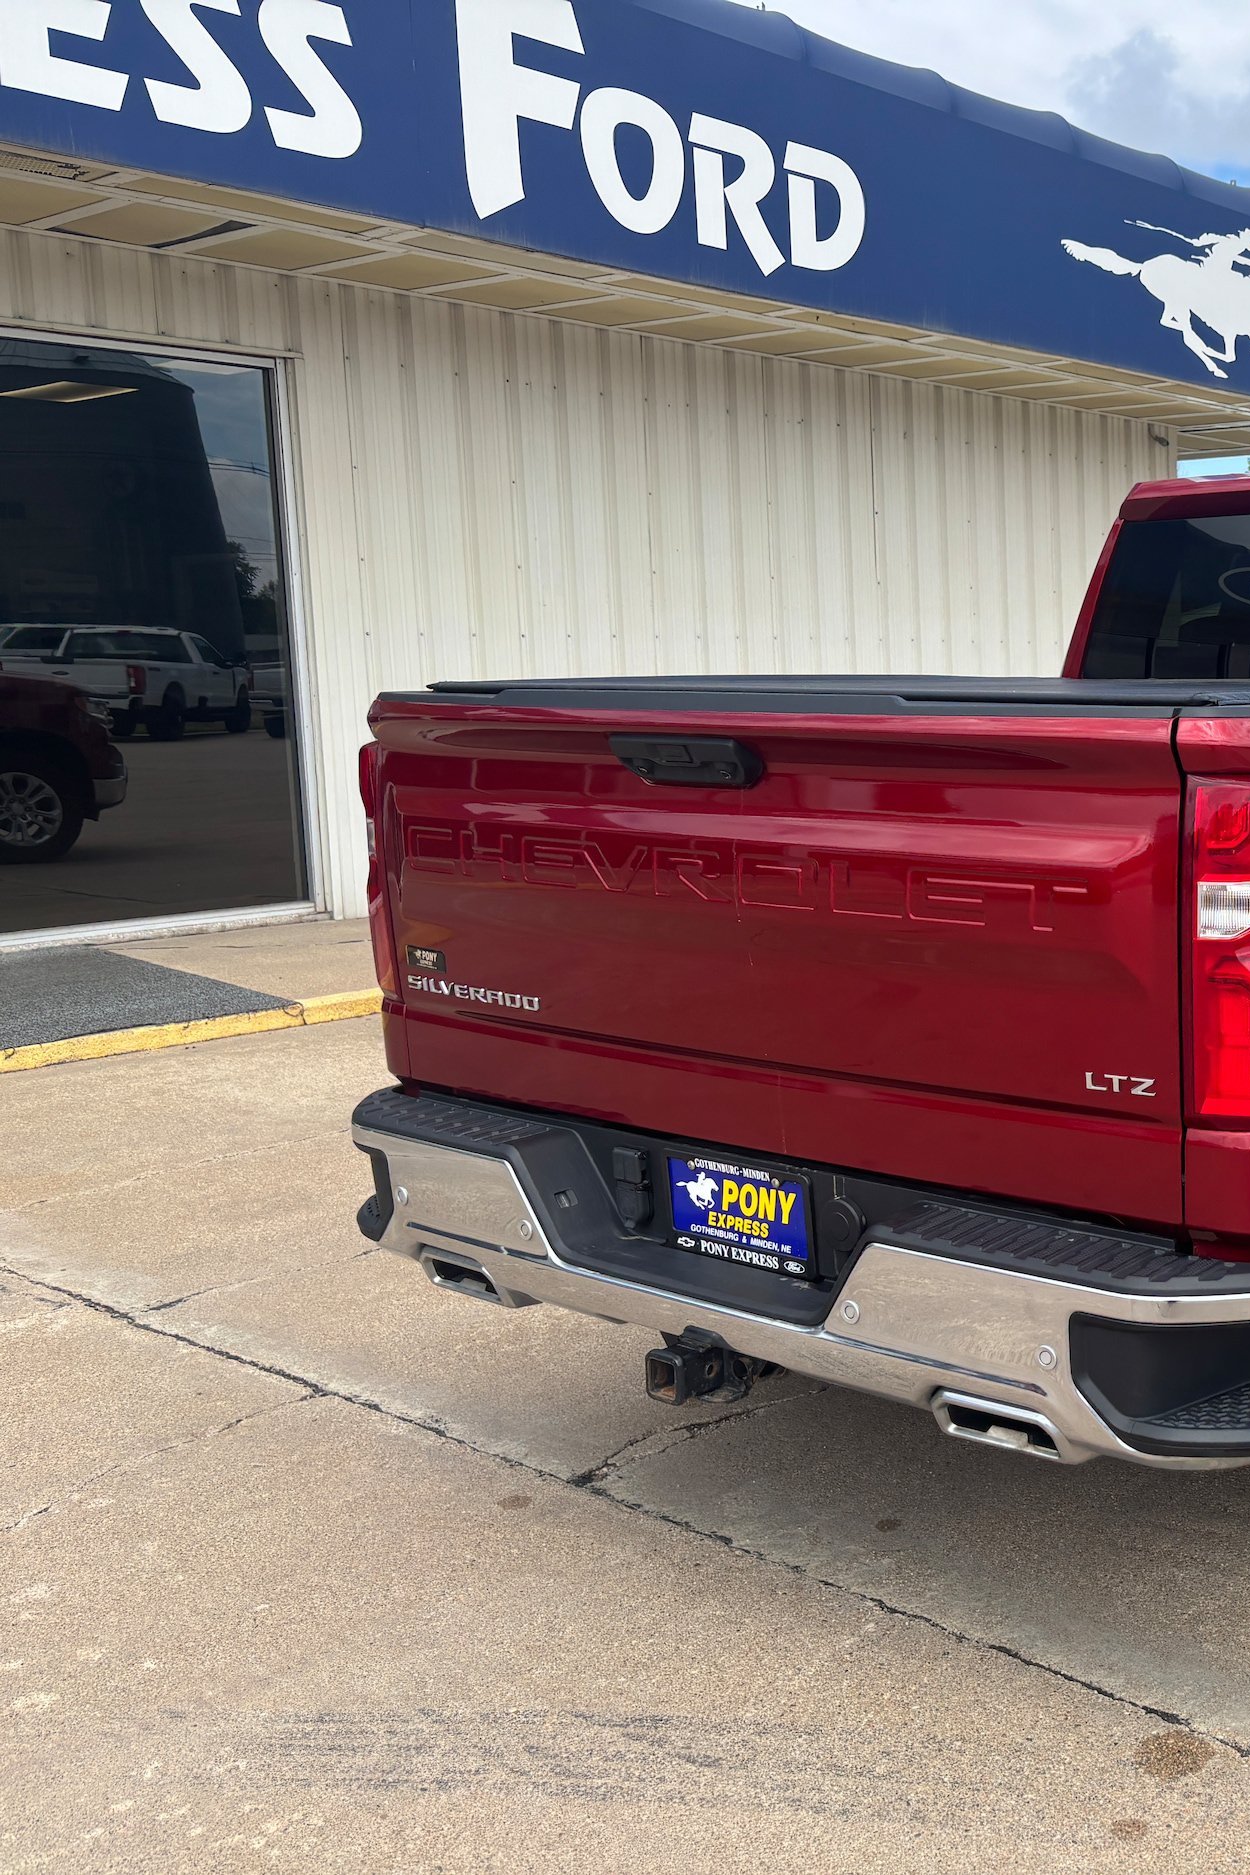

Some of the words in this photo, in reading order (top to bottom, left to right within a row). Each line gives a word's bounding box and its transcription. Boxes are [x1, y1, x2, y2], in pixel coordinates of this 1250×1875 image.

[456, 0, 866, 278] FORD
[406, 825, 1088, 931] CHEVROLET
[407, 974, 541, 1012] SILVERADO
[1085, 1071, 1157, 1097] LTZ
[721, 1179, 797, 1225] PONY
[690, 1223, 739, 1242] GOTHENBURG
[741, 1235, 748, 1244] &
[750, 1237, 780, 1253] MINDEN,
[780, 1244, 793, 1254] NE
[708, 1211, 769, 1239] EXPRESS
[700, 1239, 730, 1259] PONY
[731, 1247, 780, 1270] EXPRESS
